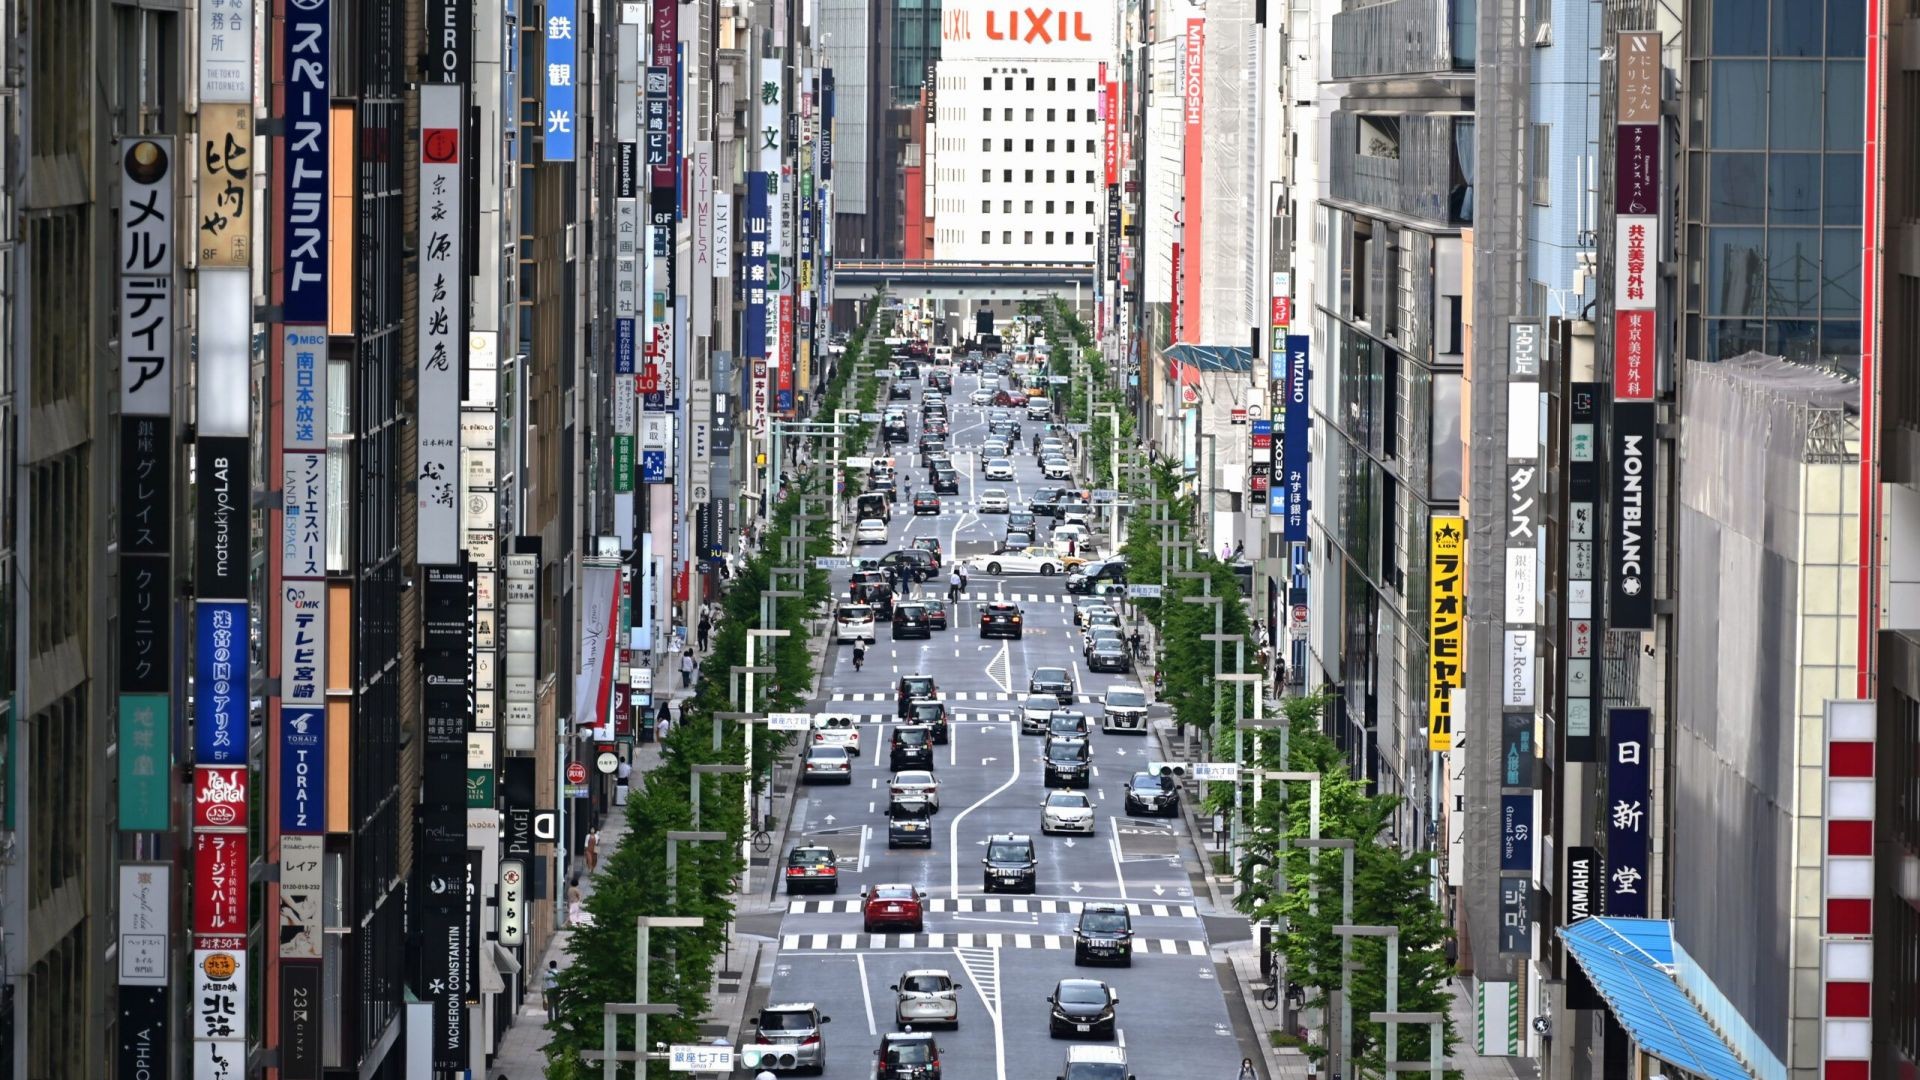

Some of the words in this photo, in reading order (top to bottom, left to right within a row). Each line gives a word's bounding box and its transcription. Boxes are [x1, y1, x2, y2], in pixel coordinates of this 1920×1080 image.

[658, 6, 672, 66] インド料理
[943, 9, 970, 41] LIXIL
[986, 7, 1092, 45] LIXIL
[206, 81, 245, 91] ATTORNEYS
[207, 69, 219, 79] THE
[219, 69, 240, 79] TOKYO
[548, 16, 571, 133] 鉄観光
[1188, 25, 1201, 124] MITSUKOSHI
[1627, 56, 1637, 119] クリニック
[1641, 56, 1651, 110] にしたん
[236, 108, 246, 130] 銀座
[650, 102, 663, 162] 岩崎ビル
[761, 81, 780, 195] 教文館
[822, 129, 830, 164] ALBION
[290, 23, 325, 292] スペーストラスト
[621, 144, 631, 197] Manneken
[1634, 128, 1643, 178] エクスパンス
[201, 133, 248, 236] 比内や
[1634, 182, 1642, 197] スパ
[655, 213, 672, 223] 6F
[717, 204, 727, 268] TASAKI
[782, 193, 790, 247] 日本香堂ビル
[202, 249, 217, 260] 8F
[233, 238, 244, 260] 本店
[751, 218, 764, 304] 山野楽器
[1628, 225, 1645, 300] 共立美容外科
[126, 190, 166, 394] メルディア
[1275, 297, 1286, 320] まつげ
[300, 335, 325, 345] MBC
[1628, 314, 1641, 395] 東京美容外科
[296, 351, 314, 441] 南日本放送
[1293, 351, 1305, 403] MIZUHO
[755, 381, 765, 436] キムラヤのパン
[136, 421, 154, 545] 銀座グレイス
[285, 469, 296, 505] LAND
[1275, 438, 1283, 481] GEOX
[214, 456, 235, 577] matsukiyoLAB
[304, 455, 318, 573] ランドエスパース
[1290, 471, 1302, 526] みずほ銀行
[1510, 467, 1536, 539] ダンス
[1622, 435, 1643, 575] MONTBLANC
[286, 516, 297, 560] ESPACE
[295, 600, 319, 609] UMK
[1515, 555, 1527, 616] 銀座リセラ
[136, 569, 153, 679] クリニック
[1433, 554, 1458, 734] ライオンビヤホール
[212, 610, 231, 746] 迷宮の国のアリス
[292, 614, 314, 698] テレビ宮崎
[1513, 634, 1527, 703] Dr.Recella
[214, 751, 229, 760] 5F
[296, 751, 307, 827] TORAIZ
[509, 805, 530, 854] PIAGET
[1506, 806, 1515, 832] Grand
[1613, 741, 1644, 894] 日新堂
[286, 861, 317, 872] レイア
[1506, 834, 1515, 860] Seiko
[212, 837, 225, 928] ラージマハール
[1572, 859, 1589, 920] YAMAHA
[506, 892, 517, 937] とらや
[1505, 891, 1518, 949] シロー
[200, 937, 242, 949] 創業50年
[448, 926, 460, 989] CONSTANTIN
[202, 994, 236, 1037] 北海
[448, 990, 460, 1050] VACHERON
[675, 1053, 730, 1063] 銀座七丁目
